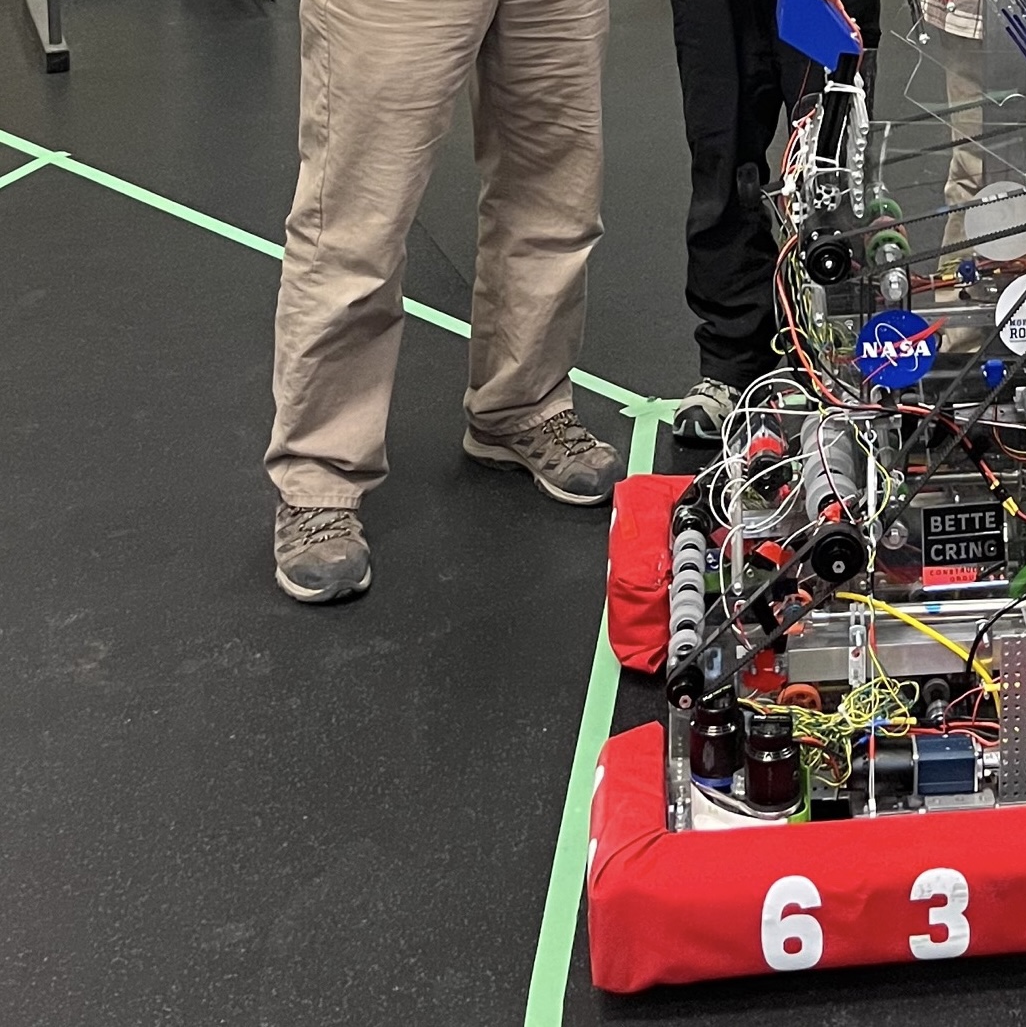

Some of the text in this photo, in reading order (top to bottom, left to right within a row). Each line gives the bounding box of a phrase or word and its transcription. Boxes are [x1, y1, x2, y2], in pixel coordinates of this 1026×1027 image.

[862, 341, 931, 358] NASA
[930, 511, 996, 533] BETTE
[930, 540, 997, 561] CRING
